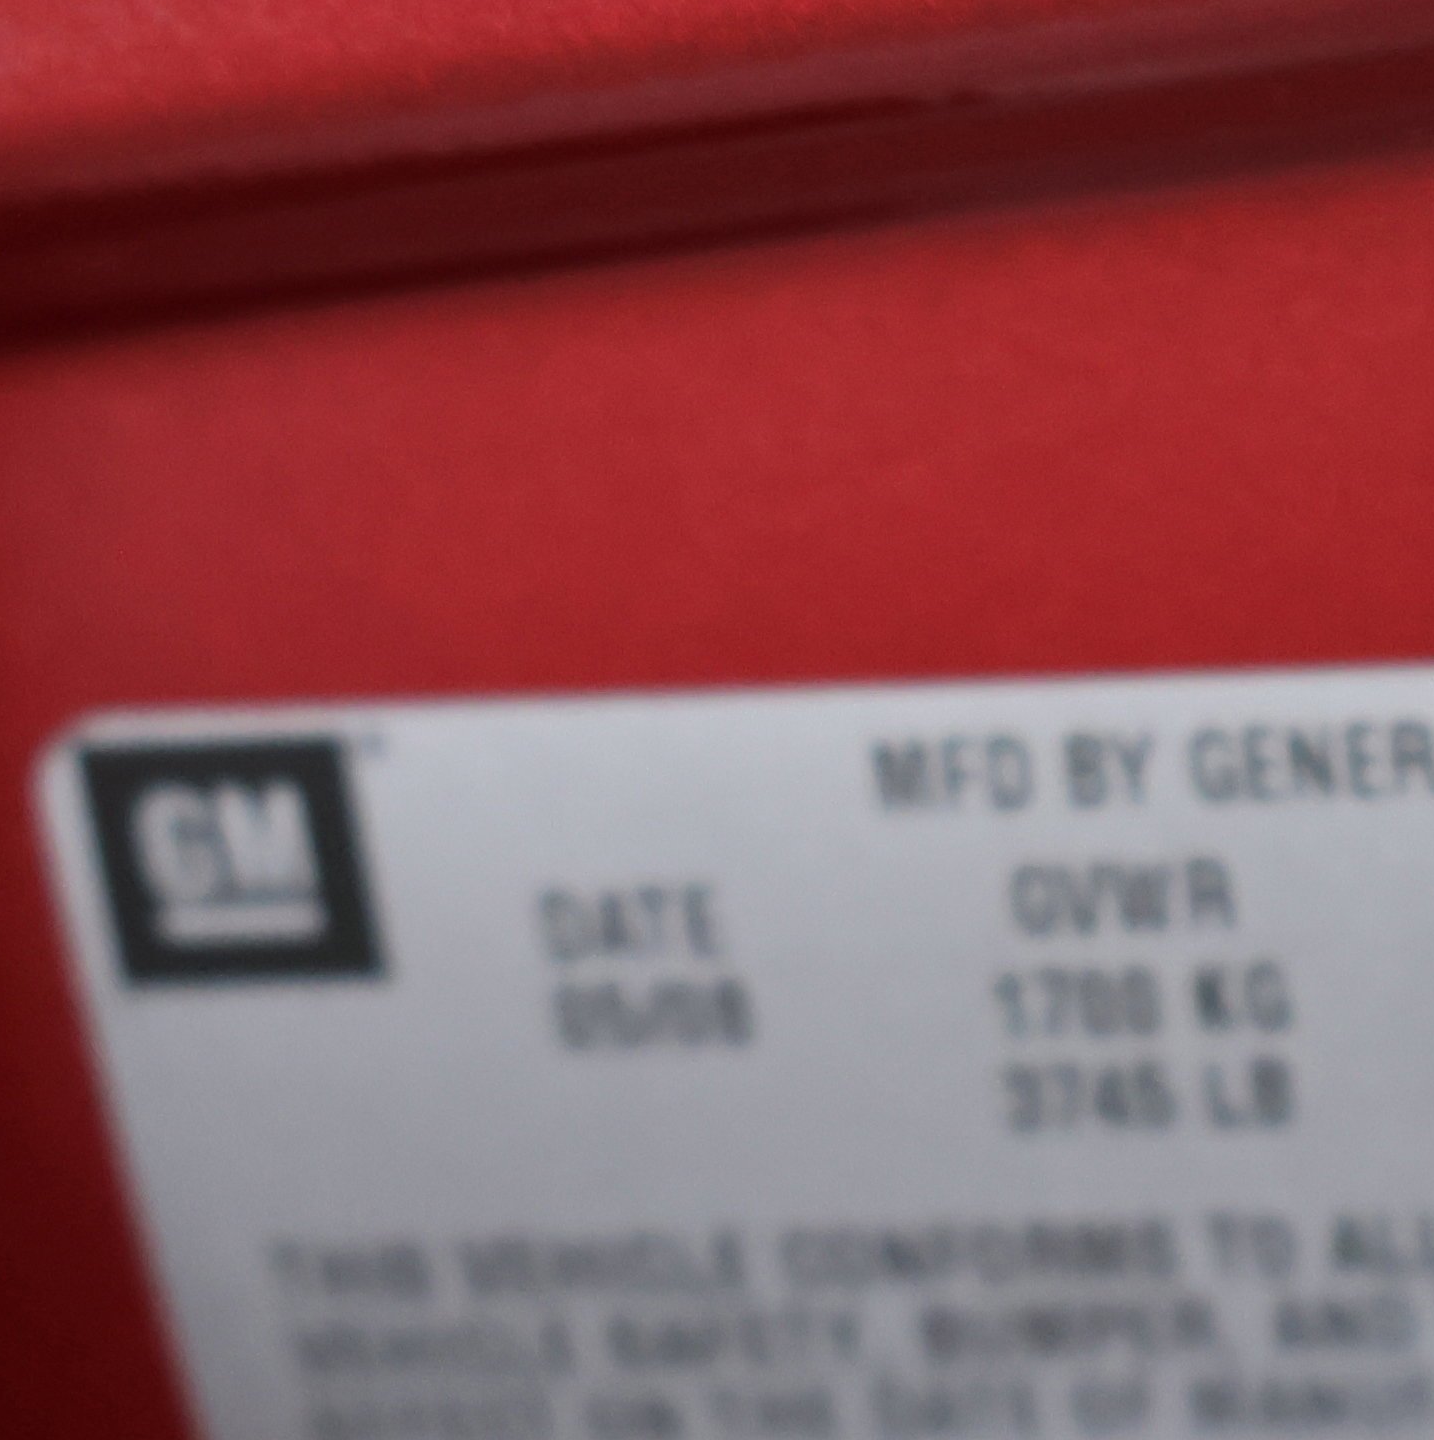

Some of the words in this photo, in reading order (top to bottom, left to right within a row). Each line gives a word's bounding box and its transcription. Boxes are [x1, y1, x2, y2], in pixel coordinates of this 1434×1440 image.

[871, 732, 1034, 812] MFD
[1064, 727, 1154, 810] BY
[134, 775, 326, 902] GM
[538, 882, 724, 965] DATE
[1008, 855, 1236, 938] GVWR
[1191, 955, 1296, 1035] KG
[1202, 1052, 1296, 1132] LB
[774, 1210, 1176, 1292] CONFORMS
[1202, 1208, 1301, 1280] TO
